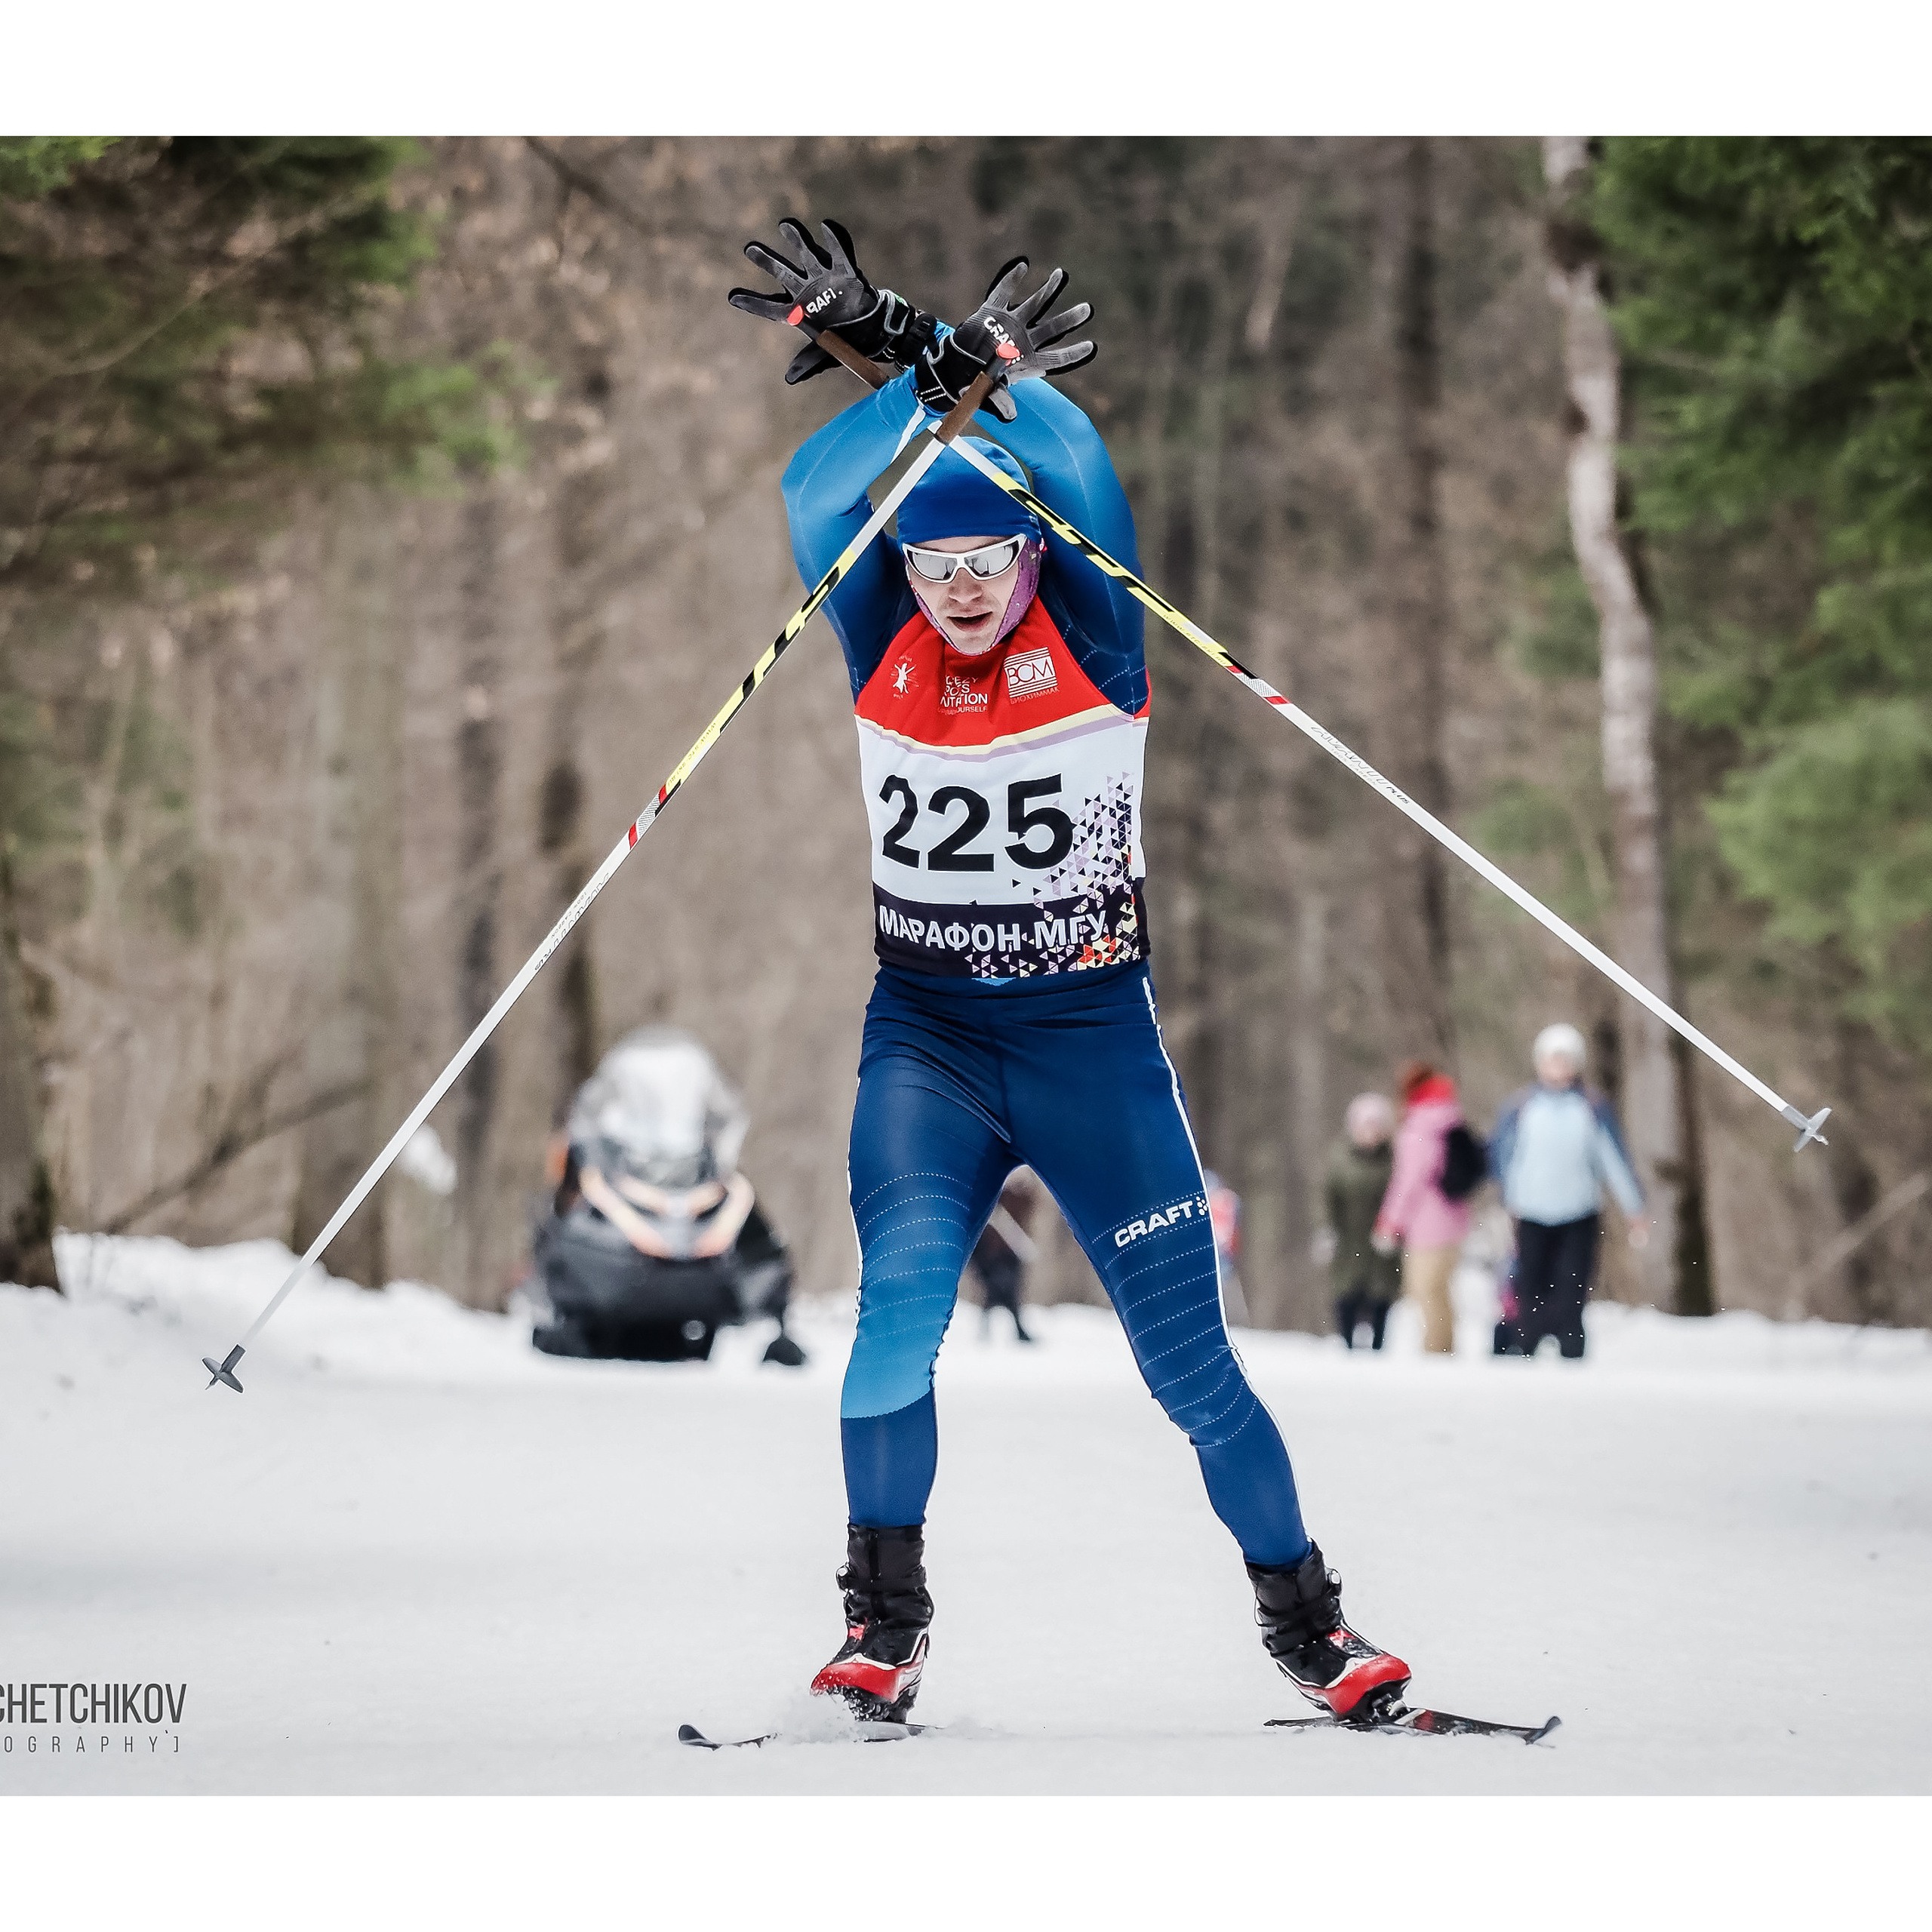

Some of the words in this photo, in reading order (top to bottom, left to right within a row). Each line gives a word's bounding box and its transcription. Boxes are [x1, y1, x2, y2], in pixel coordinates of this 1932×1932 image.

[878, 773, 1074, 872] 225
[878, 905, 1021, 952] МАРАФОН
[1034, 910, 1106, 950] МГУ
[1115, 1200, 1193, 1248] CRAFT
